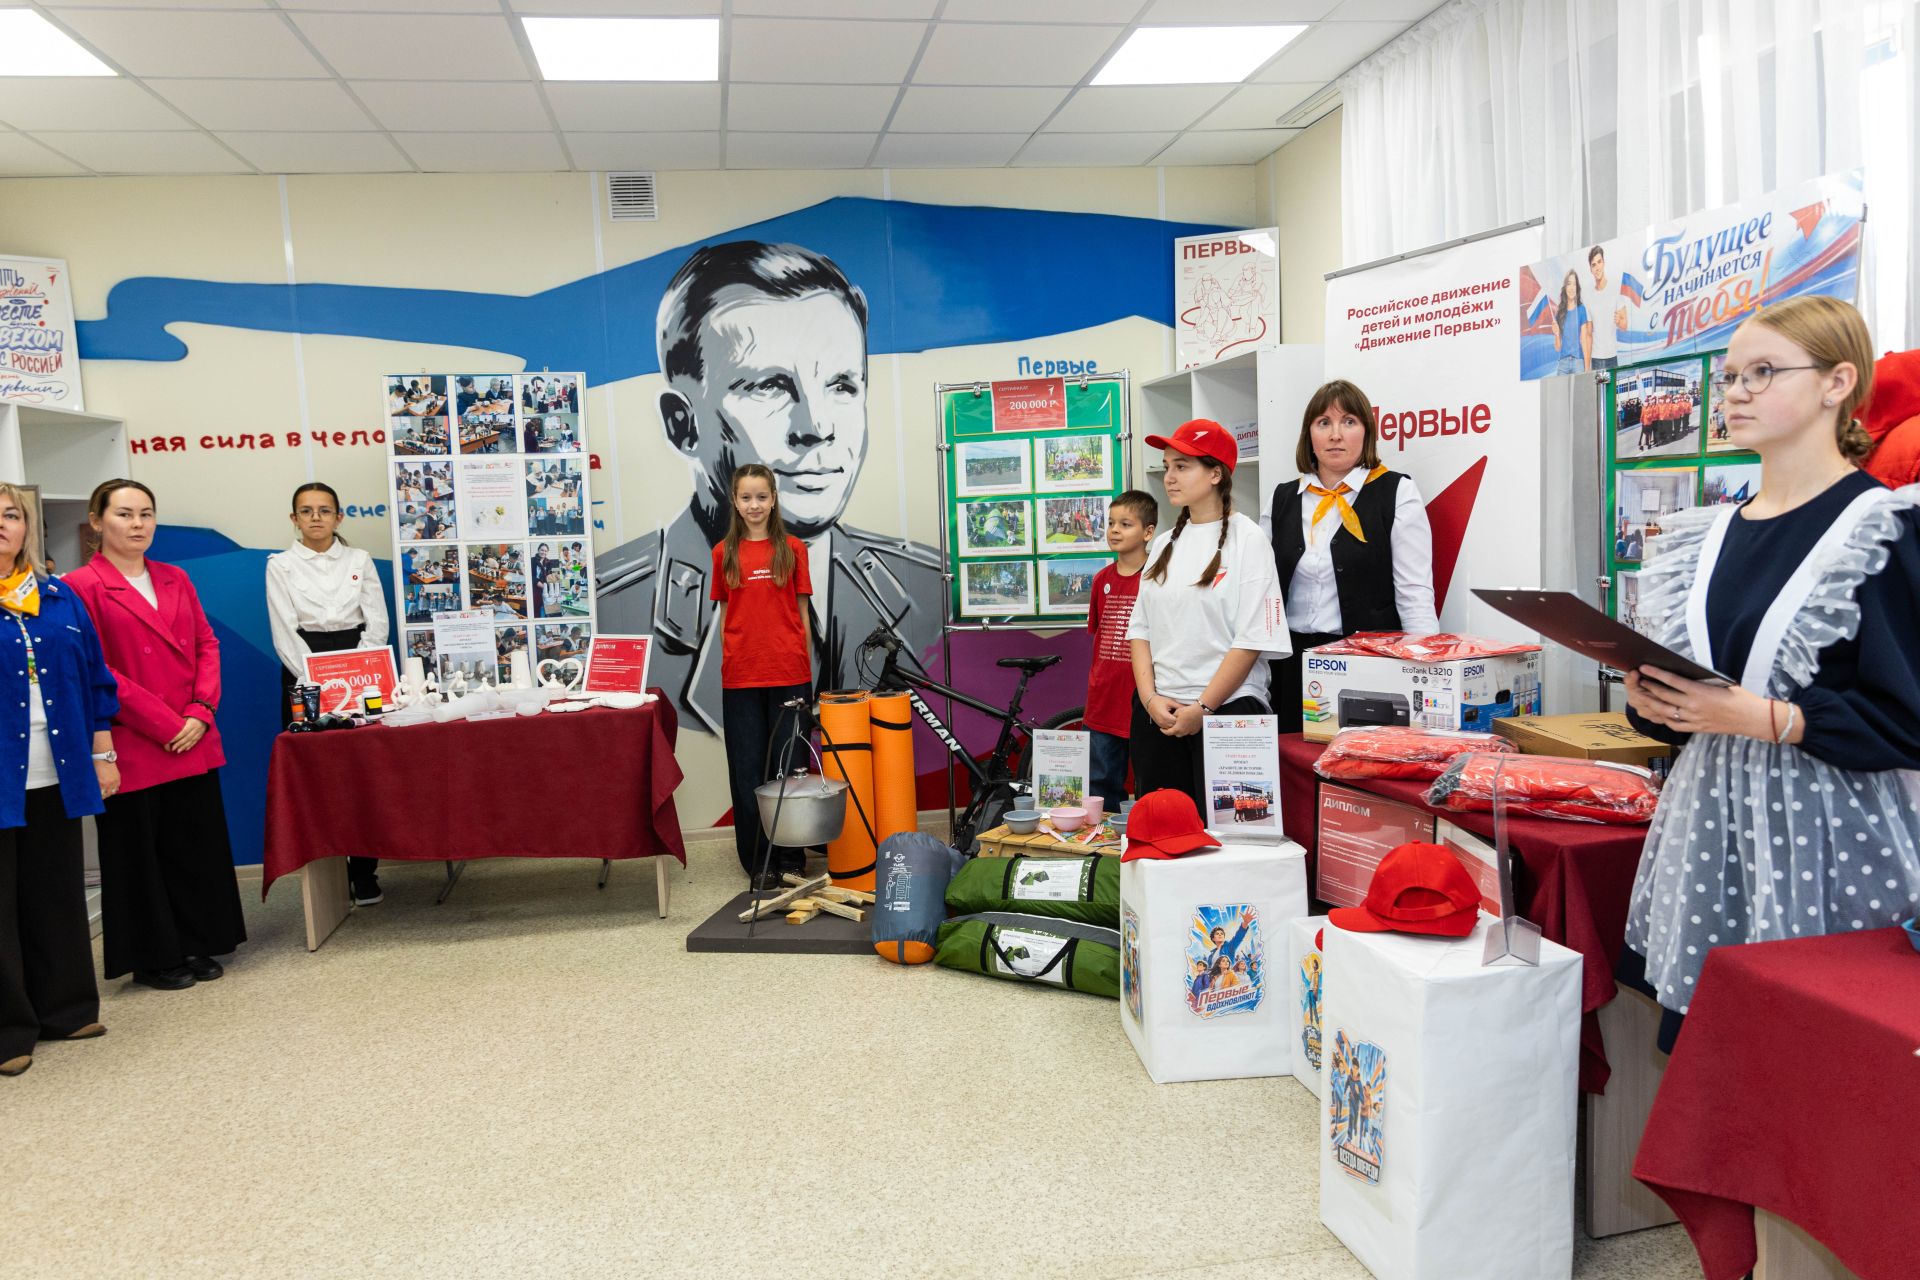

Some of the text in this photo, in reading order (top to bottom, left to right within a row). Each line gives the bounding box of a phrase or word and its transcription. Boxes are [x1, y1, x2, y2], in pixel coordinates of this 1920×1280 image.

[1183, 240, 1257, 260] ПЕРВЫ
[1643, 211, 1772, 301] Будущее
[1347, 277, 1511, 320] Российское движение
[1361, 300, 1494, 335] детей и молодёжи
[0, 326, 63, 352] ВЕКОМ
[1355, 316, 1501, 351] «Движение Первых»
[1018, 356, 1098, 378] Первые
[1009, 400, 1028, 410] 200
[1029, 399, 1048, 409] 000
[131, 429, 386, 454] ная сила в чело
[1308, 658, 1347, 672] EPSON
[1402, 666, 1453, 677] EcoTank L3210
[1464, 664, 1485, 677] EPSON
[1323, 798, 1371, 817] ДИПЛОМ
[1199, 984, 1250, 1006] Первые
